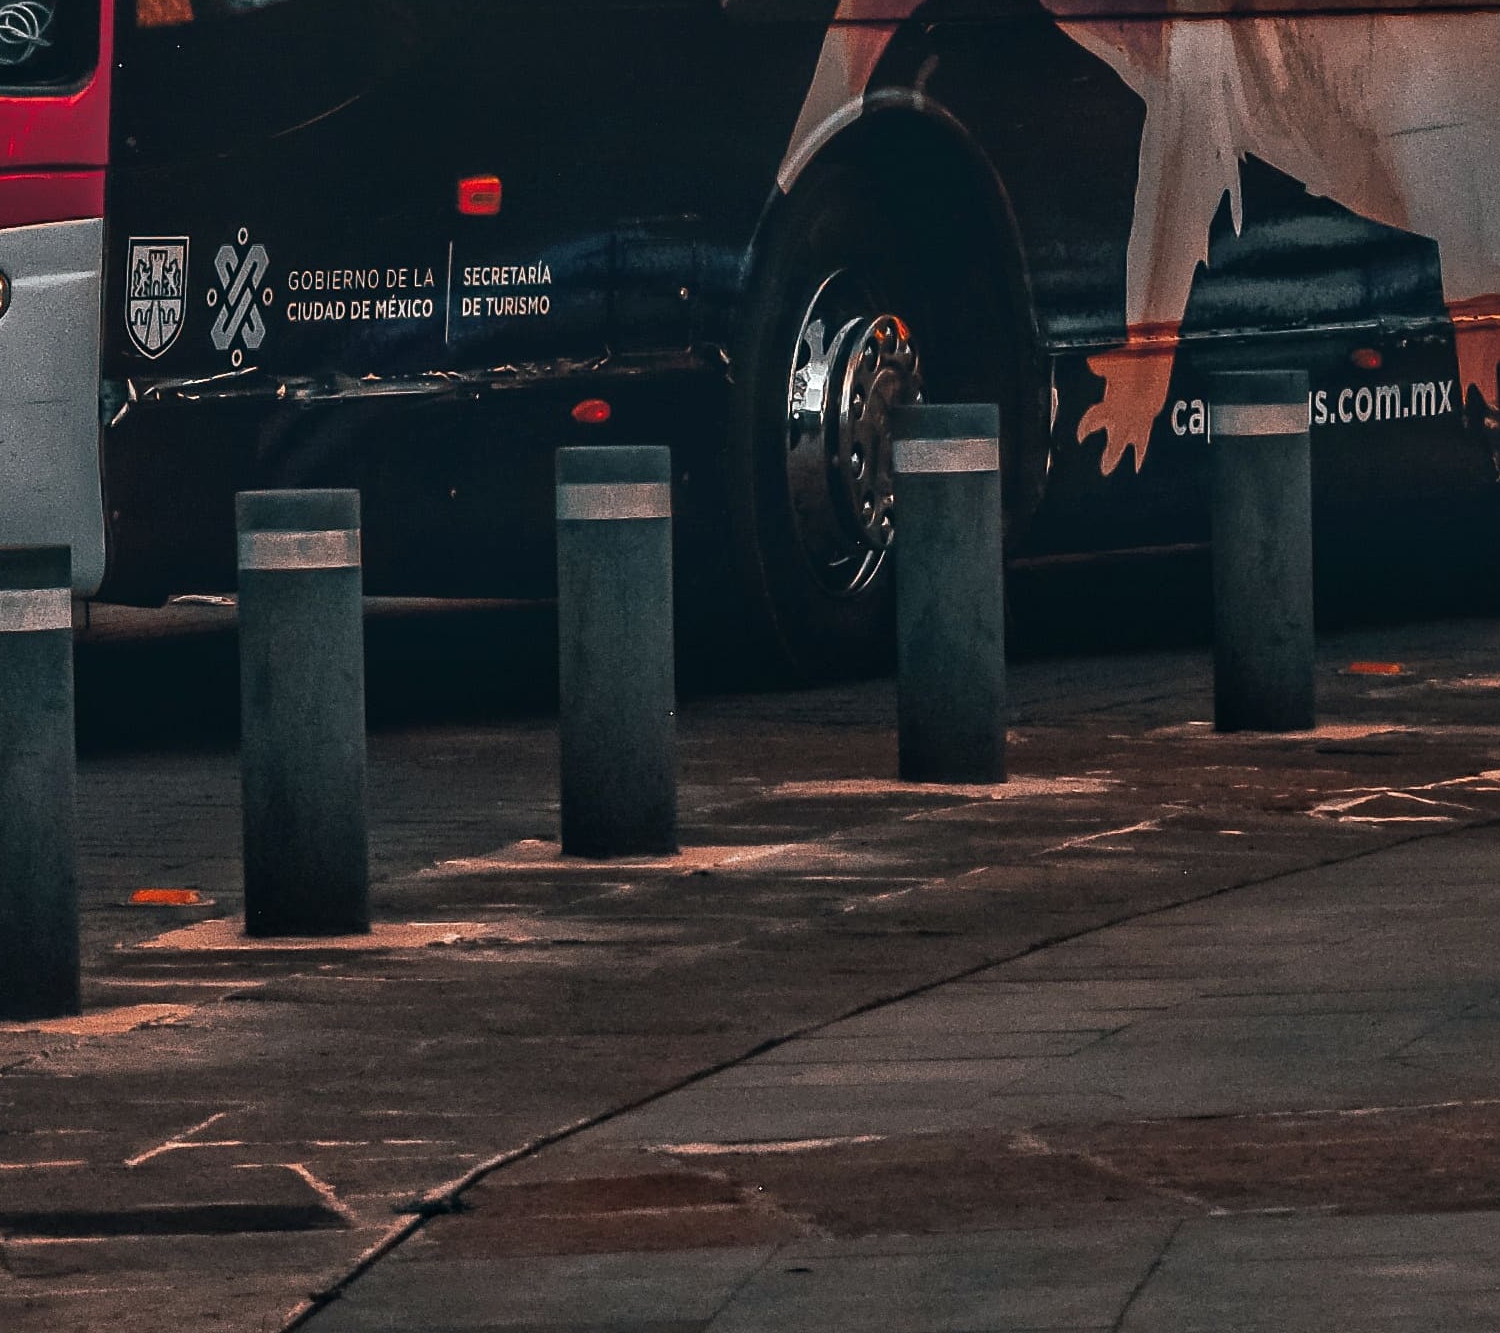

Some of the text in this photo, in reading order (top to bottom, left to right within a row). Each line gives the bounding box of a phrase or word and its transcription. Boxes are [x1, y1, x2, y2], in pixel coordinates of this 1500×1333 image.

[288, 267, 435, 291] GOBIERNO DE LA
[463, 260, 552, 286] SECRETARÍA
[287, 294, 434, 322] CIUDAD DE MÉXICO
[461, 295, 550, 317] DE TURISMO
